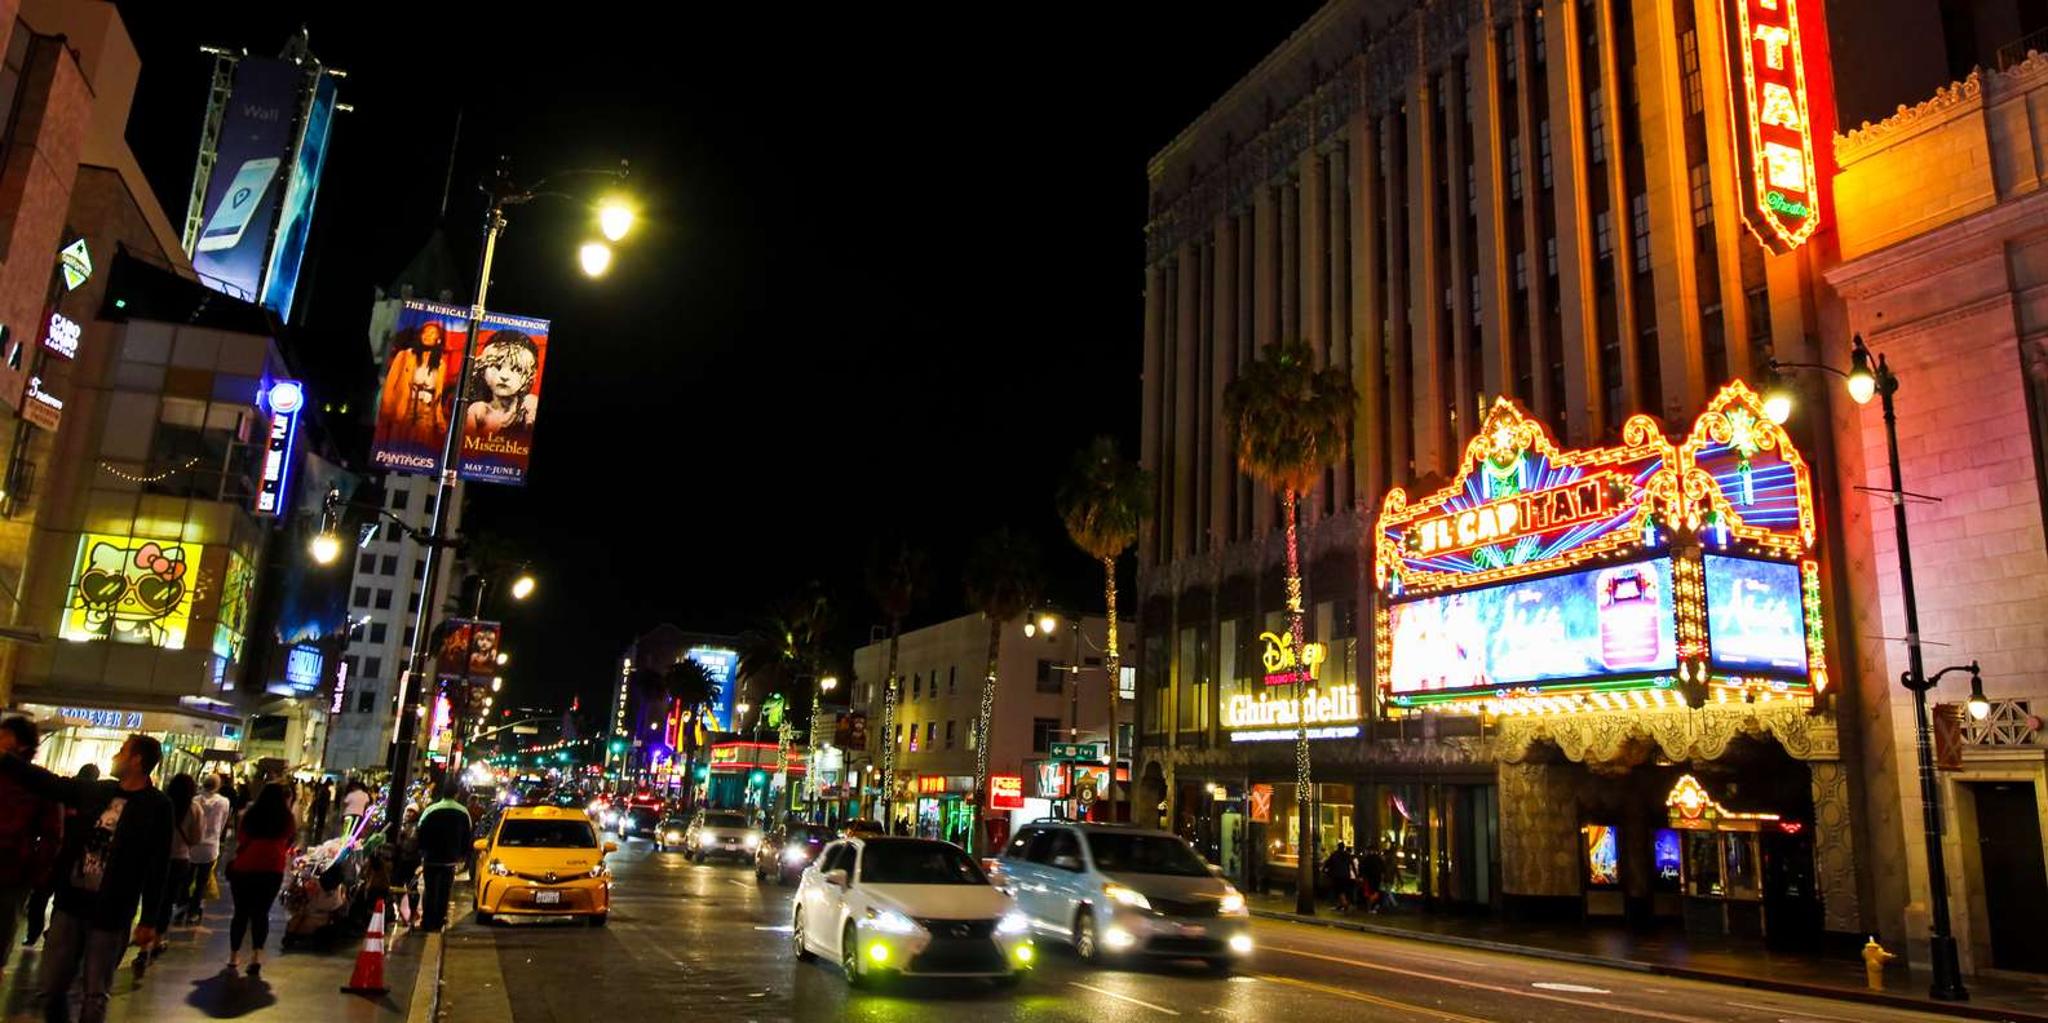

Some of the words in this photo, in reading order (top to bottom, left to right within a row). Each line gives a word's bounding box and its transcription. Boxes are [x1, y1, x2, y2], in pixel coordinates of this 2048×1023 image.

[243, 104, 279, 123] Wall
[405, 300, 423, 311] THE
[427, 304, 467, 318] MUSICAL
[488, 432, 504, 442] Les
[375, 451, 435, 469] PANTAGES
[464, 463, 483, 472] MAY
[1458, 480, 1601, 546] CAPITAN
[126, 712, 143, 728] 21
